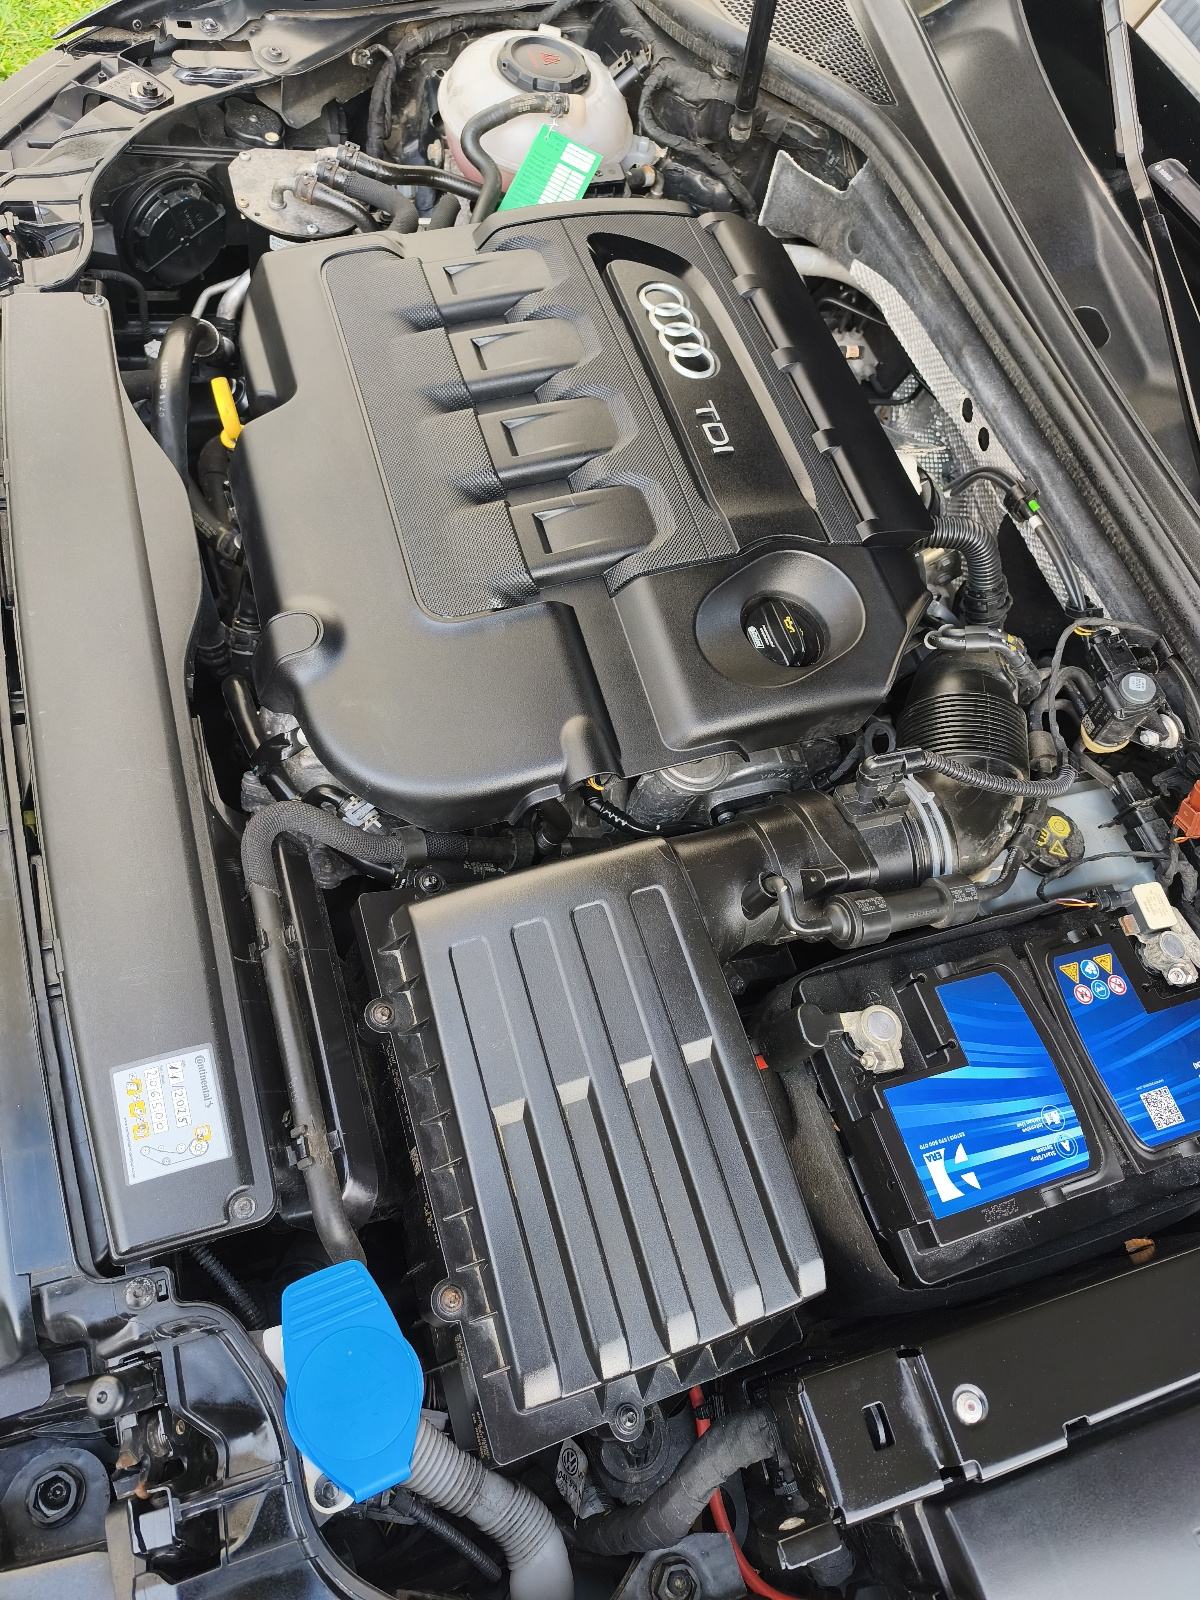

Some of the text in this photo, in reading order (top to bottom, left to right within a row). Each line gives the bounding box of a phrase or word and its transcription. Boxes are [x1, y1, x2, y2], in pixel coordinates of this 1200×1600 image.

[695, 399, 735, 454] TDI
[194, 1054, 212, 1102] Continental
[926, 1151, 943, 1163] ERA
[1030, 1150, 1057, 1163] Start/Stop
